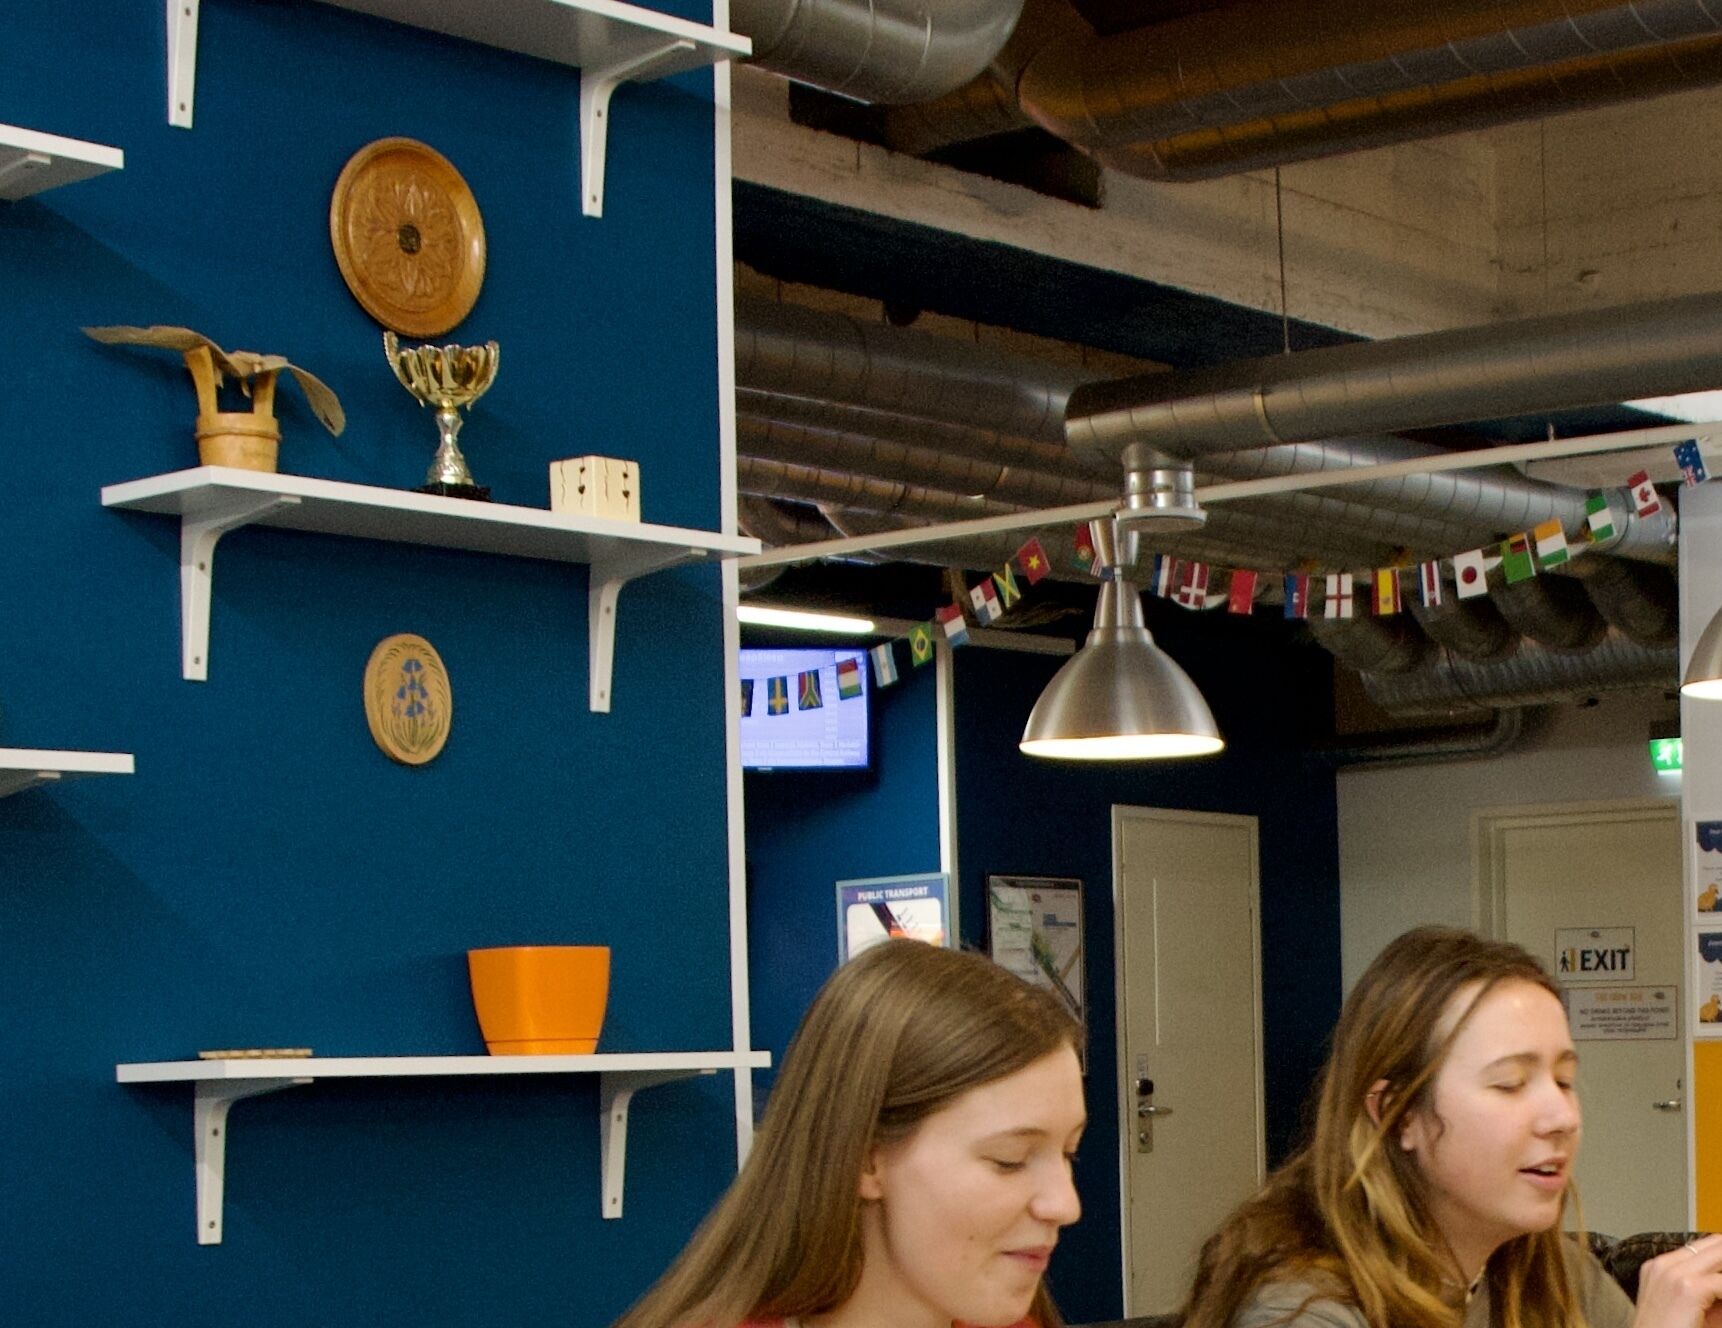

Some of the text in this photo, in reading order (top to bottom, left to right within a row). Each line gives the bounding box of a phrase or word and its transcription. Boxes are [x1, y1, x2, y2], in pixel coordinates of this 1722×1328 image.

[857, 886, 929, 901] PUBLIC TRANSPORT
[1580, 948, 1630, 972] EXIT
